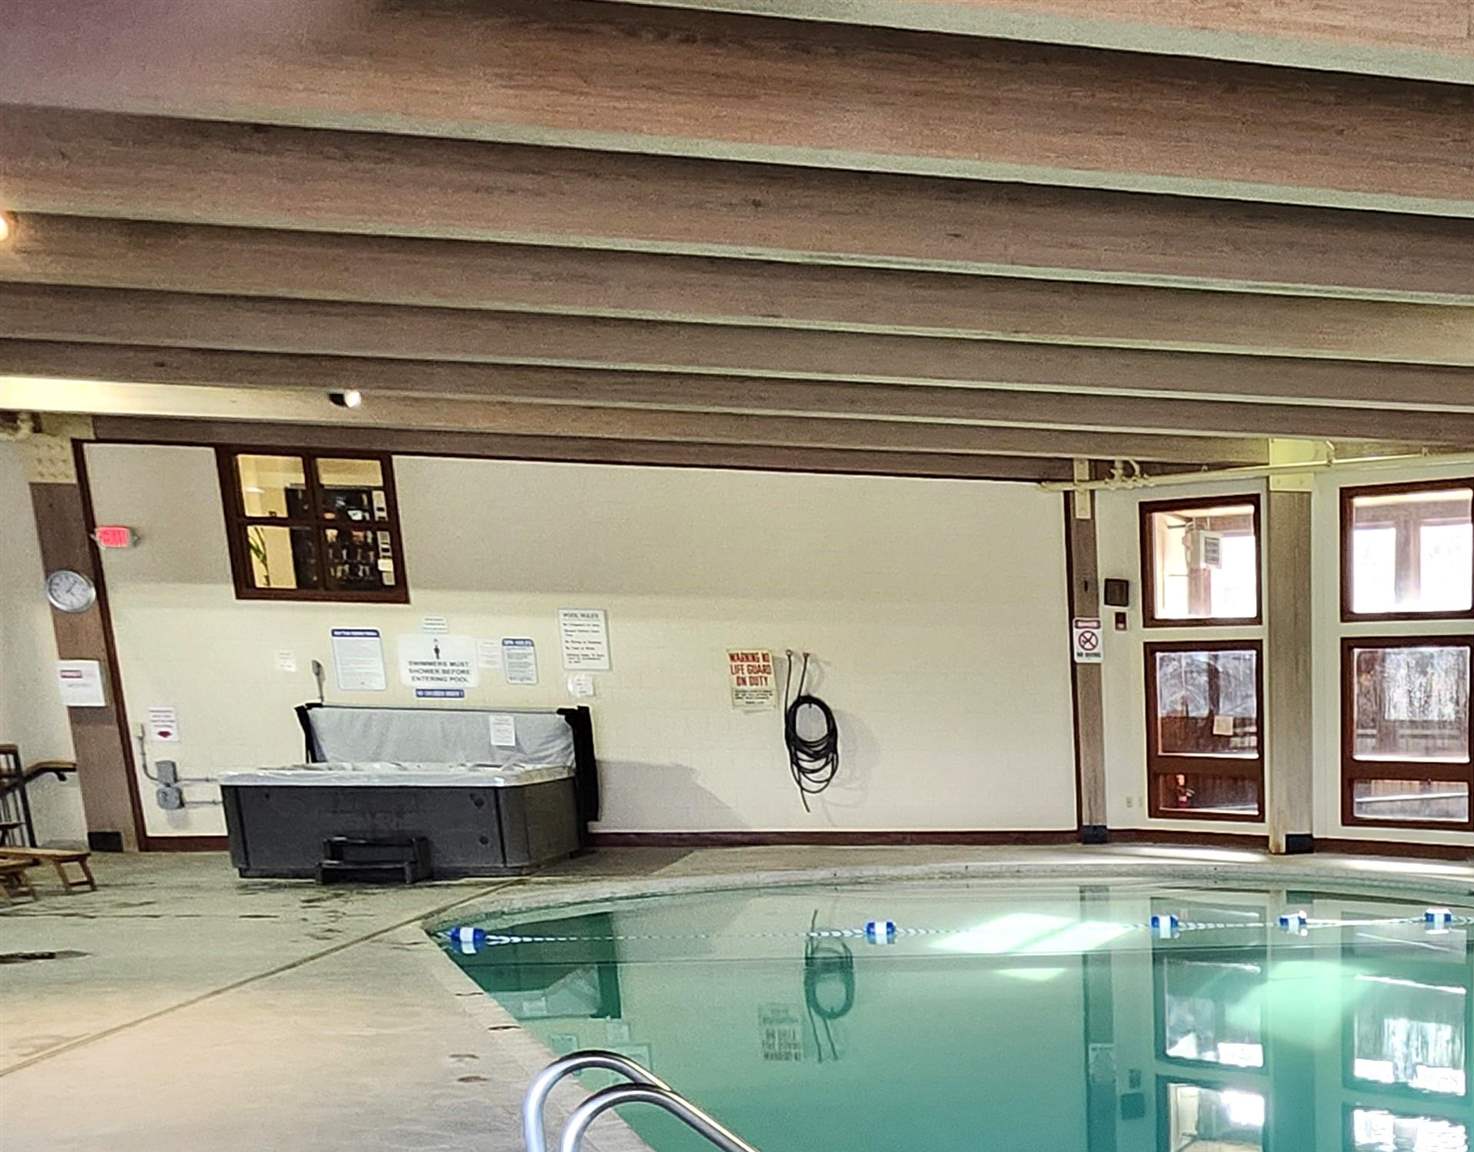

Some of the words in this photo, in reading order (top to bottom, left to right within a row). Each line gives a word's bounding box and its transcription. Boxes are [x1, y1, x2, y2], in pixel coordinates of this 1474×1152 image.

[730, 664, 745, 676] LIFE
[736, 676, 747, 687] ON
[749, 676, 768, 687] DUTY
